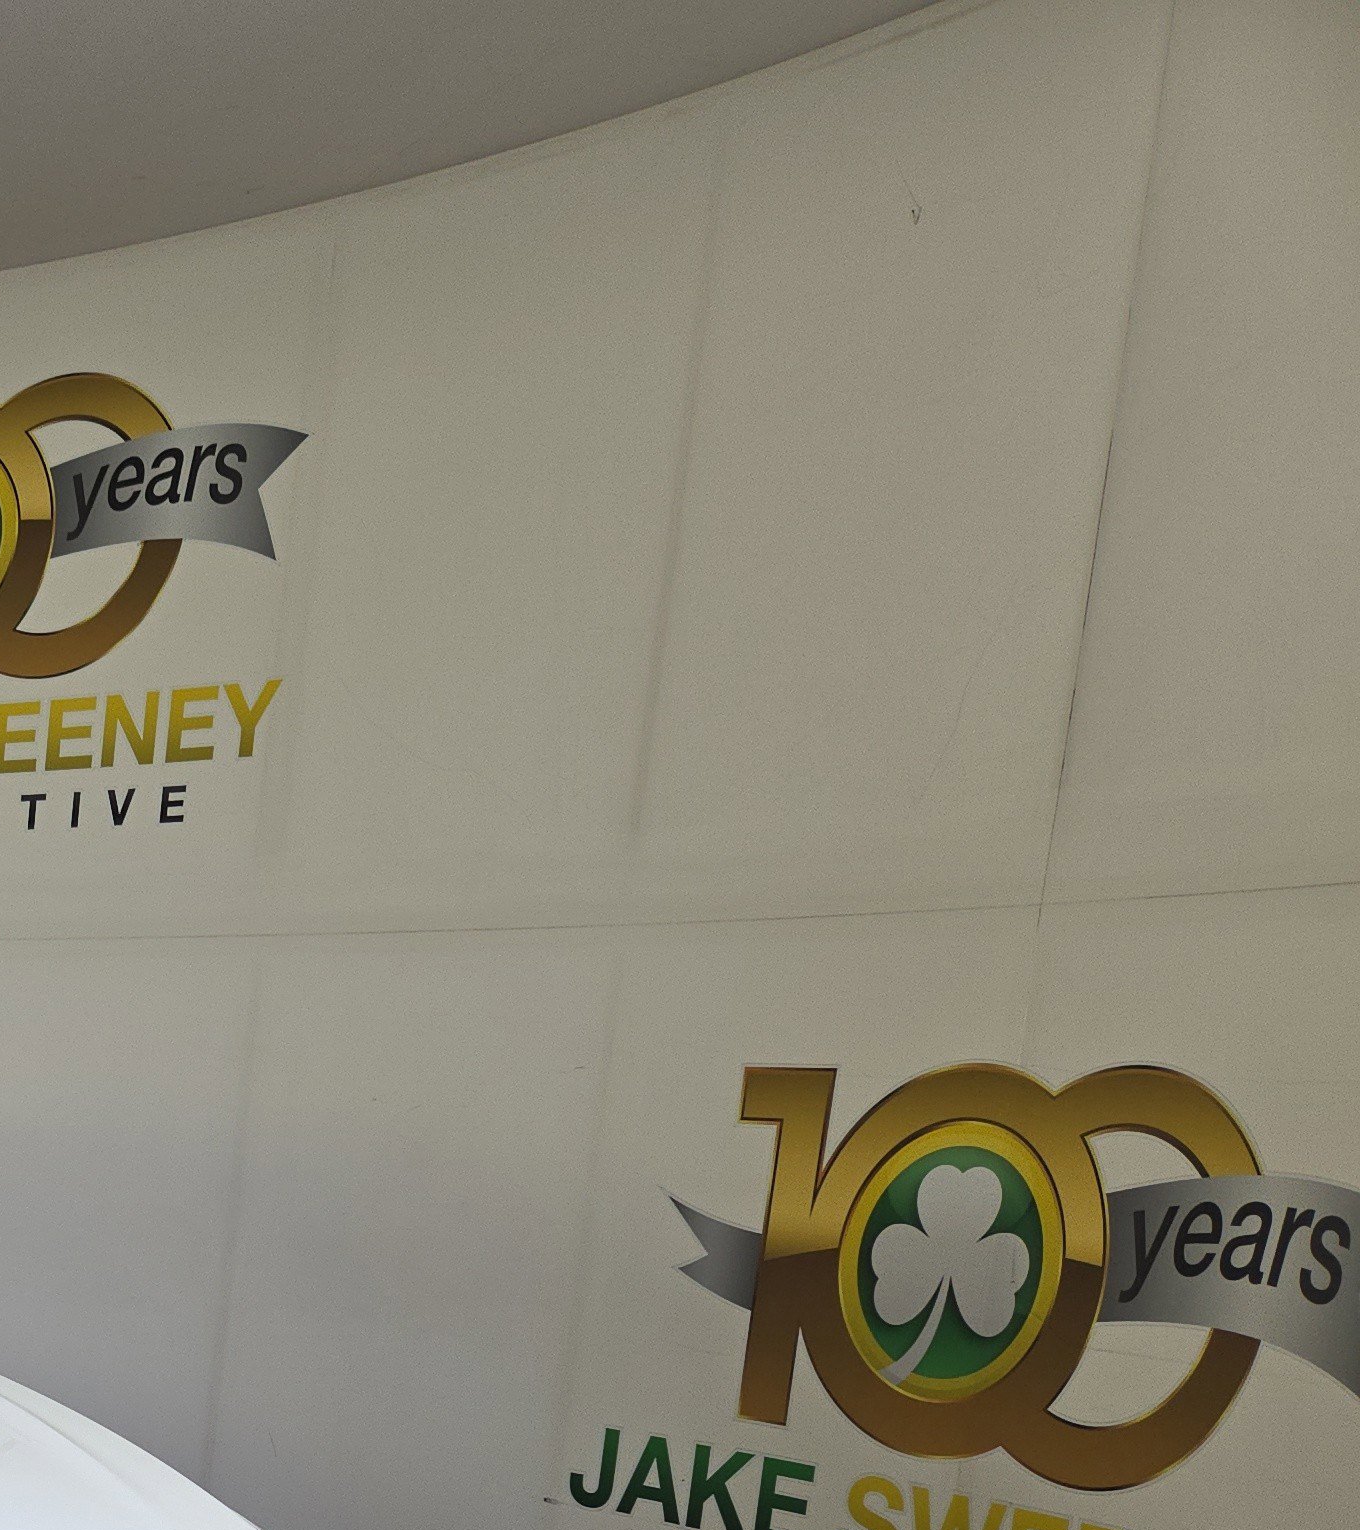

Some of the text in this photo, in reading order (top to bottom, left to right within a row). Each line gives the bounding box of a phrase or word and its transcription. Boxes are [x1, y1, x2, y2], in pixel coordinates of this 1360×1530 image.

[66, 439, 249, 541] years
[737, 1062, 1352, 1492] 100 years
